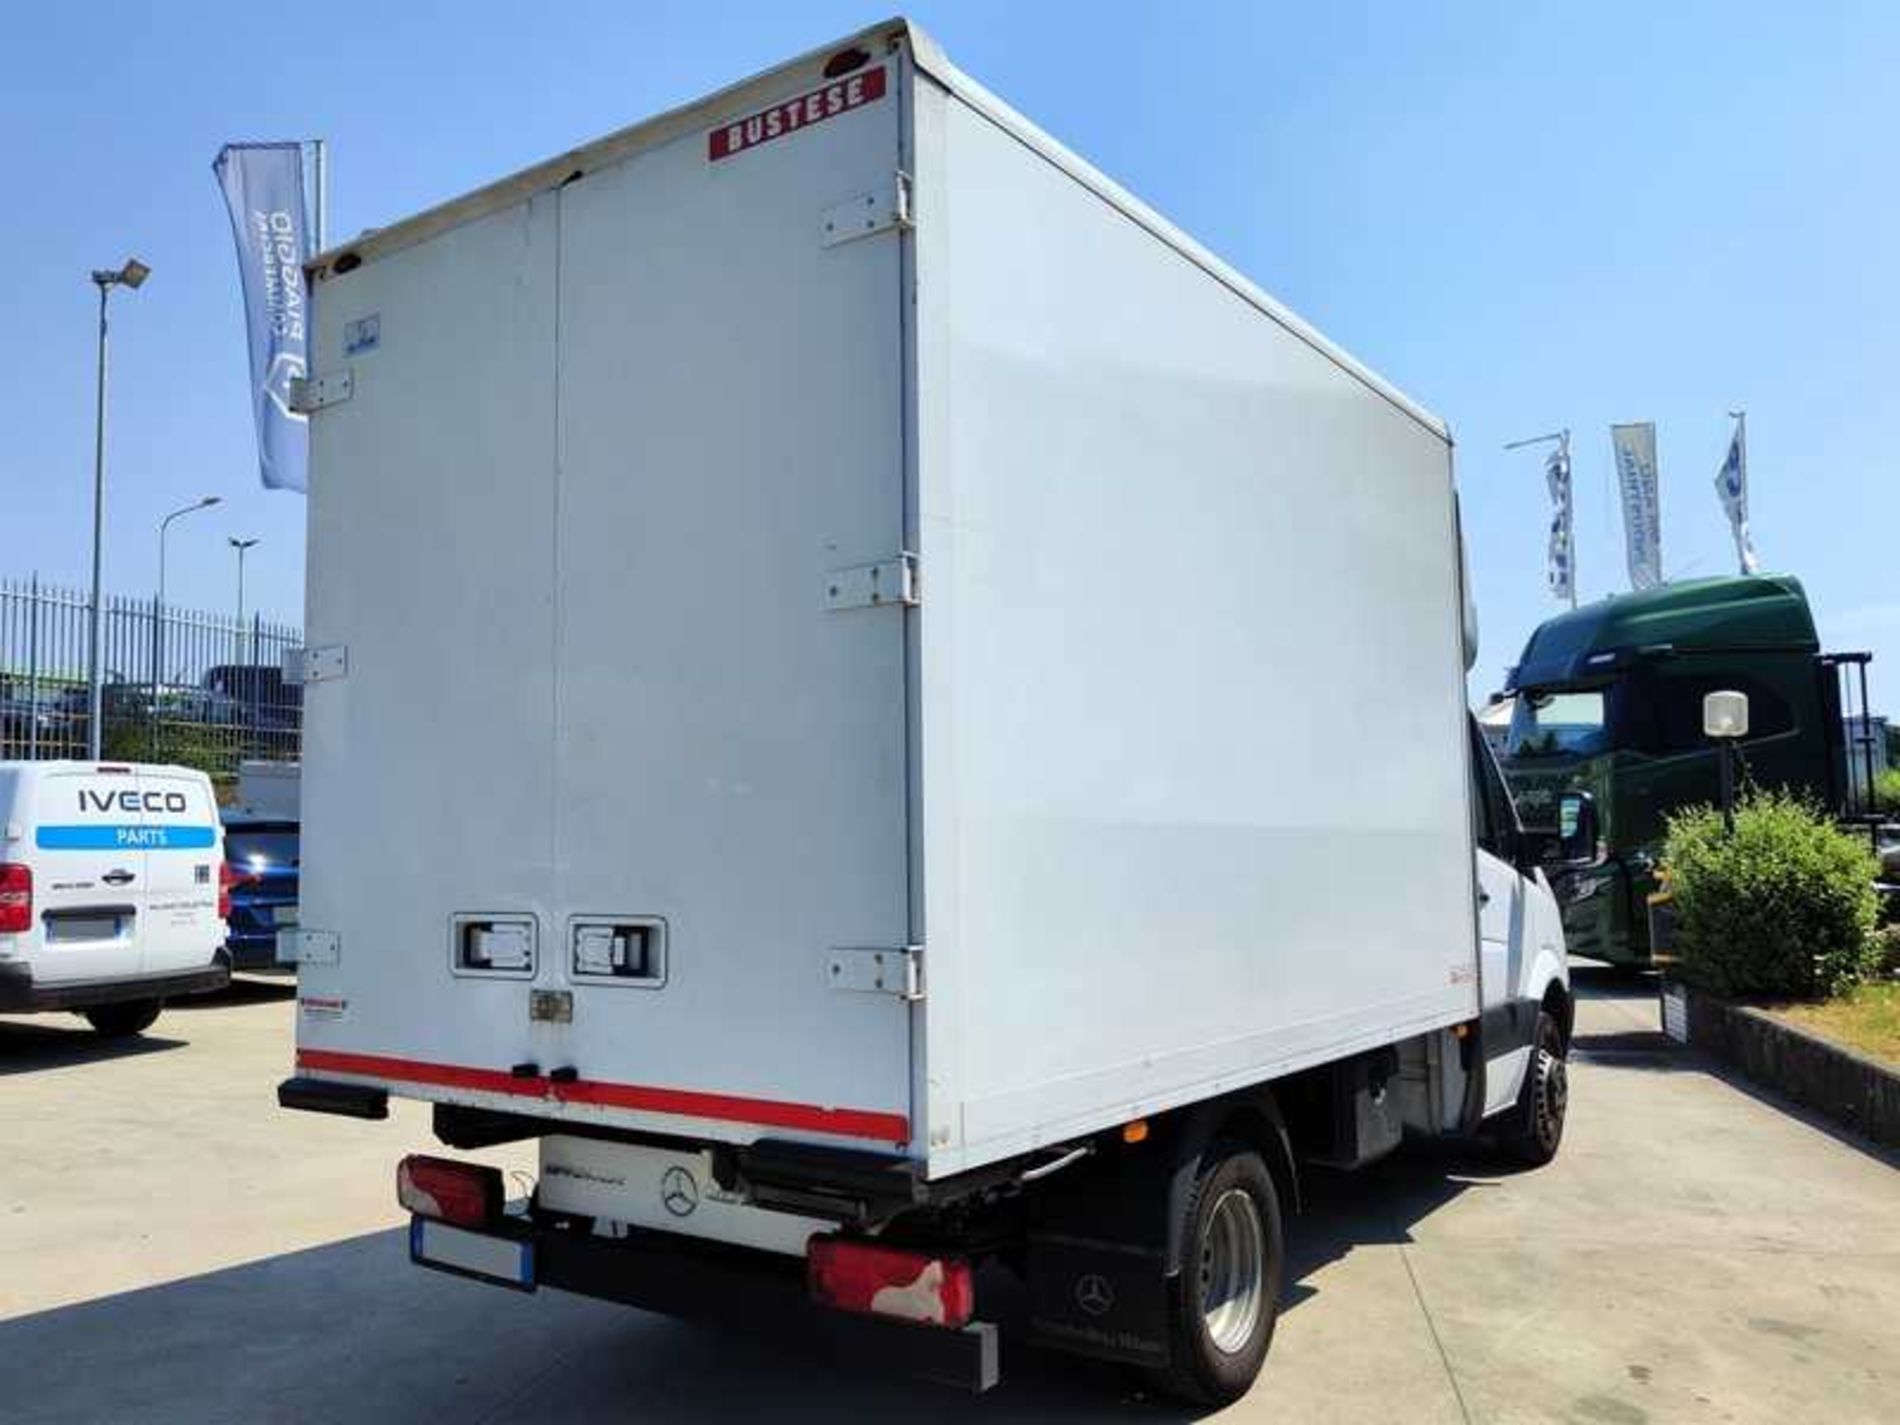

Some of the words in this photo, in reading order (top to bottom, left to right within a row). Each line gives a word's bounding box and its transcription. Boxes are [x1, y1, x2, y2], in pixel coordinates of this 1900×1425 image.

[728, 78, 863, 151] BUSTESE
[79, 790, 186, 812] IVECO
[116, 828, 168, 846] PARTS
